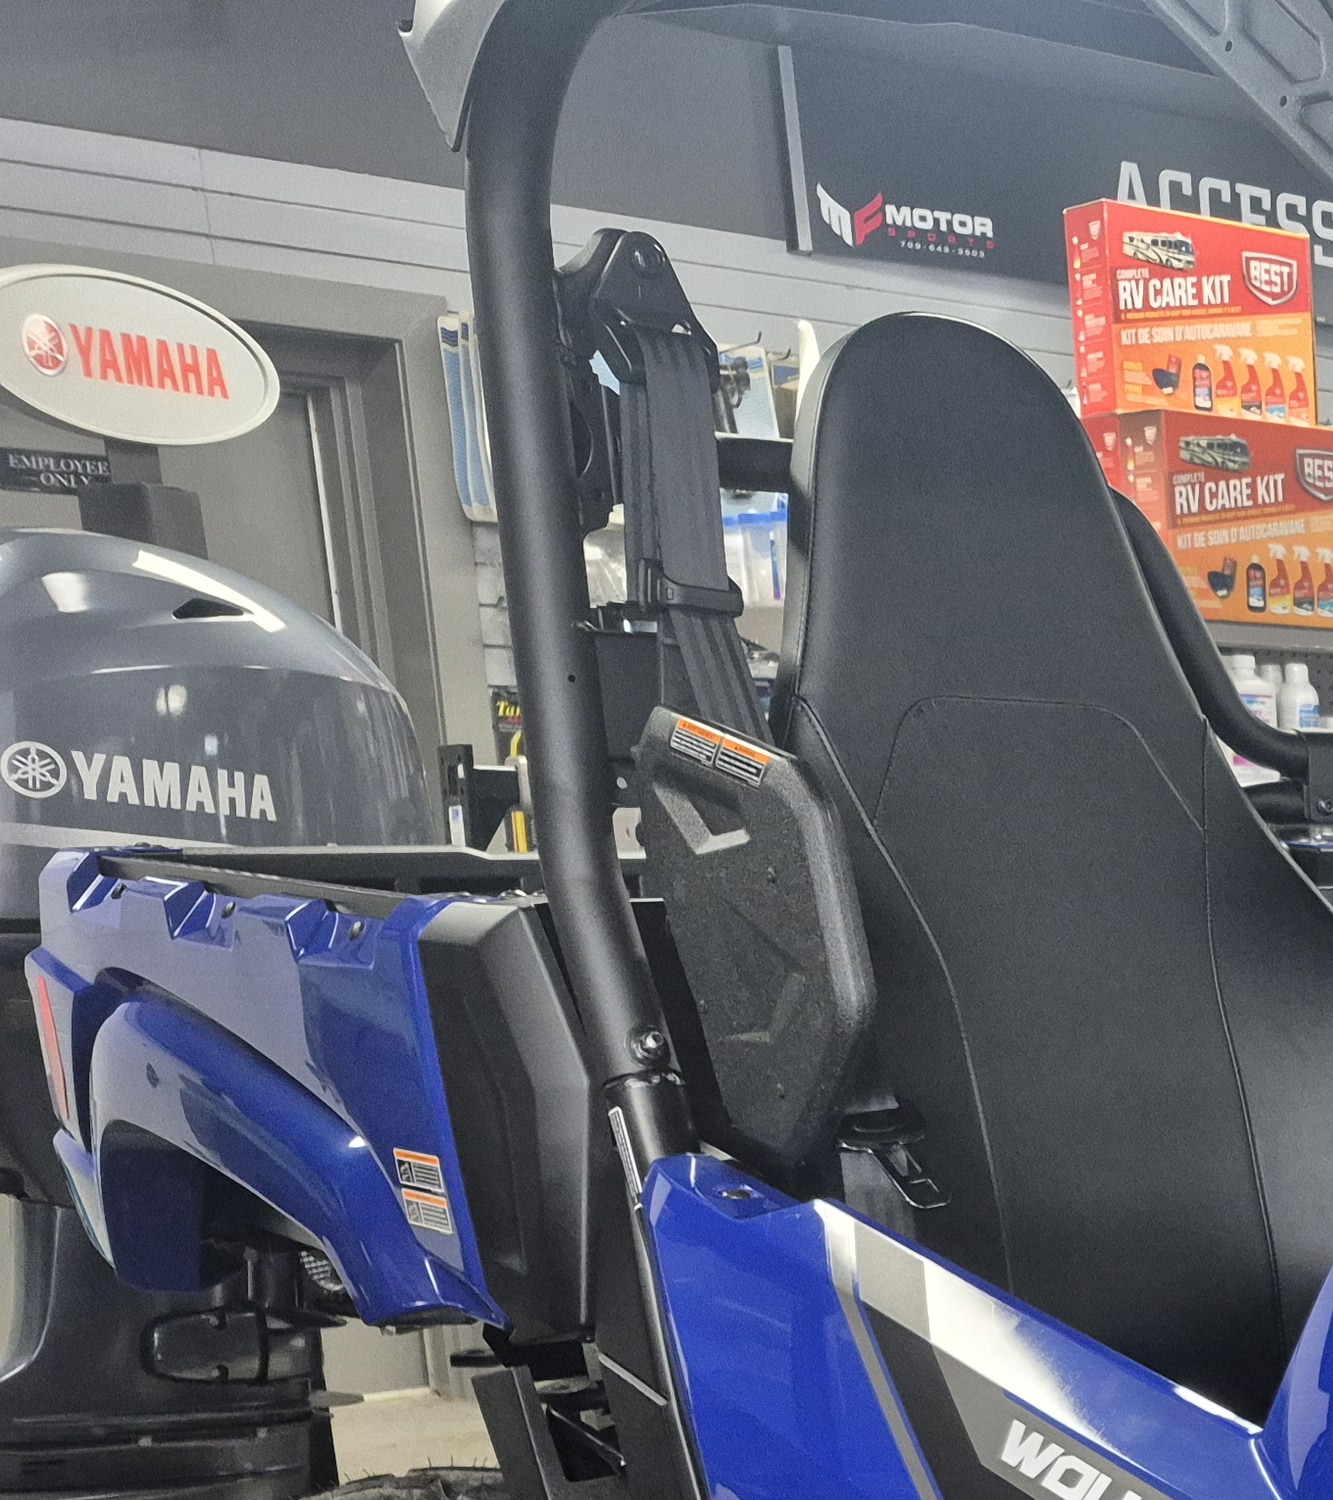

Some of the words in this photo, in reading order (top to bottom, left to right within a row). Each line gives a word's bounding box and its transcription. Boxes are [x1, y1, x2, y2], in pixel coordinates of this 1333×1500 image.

[885, 204, 993, 238] MOTOR
[1118, 279, 1144, 310] RV
[1149, 276, 1199, 308] CARE
[1201, 275, 1231, 305] KIT
[1249, 260, 1293, 293] BEST
[1120, 329, 1136, 345] KIT
[68, 323, 229, 400] YAMAHA
[8, 454, 110, 475] EMPLOYEE
[1174, 484, 1200, 515] RV
[1205, 477, 1253, 511] CARE
[1257, 473, 1285, 505] KIT
[1177, 531, 1193, 549] KIT
[1194, 529, 1207, 546] DE
[1208, 526, 1229, 545] SOIN
[71, 750, 277, 822] YAMAHA
